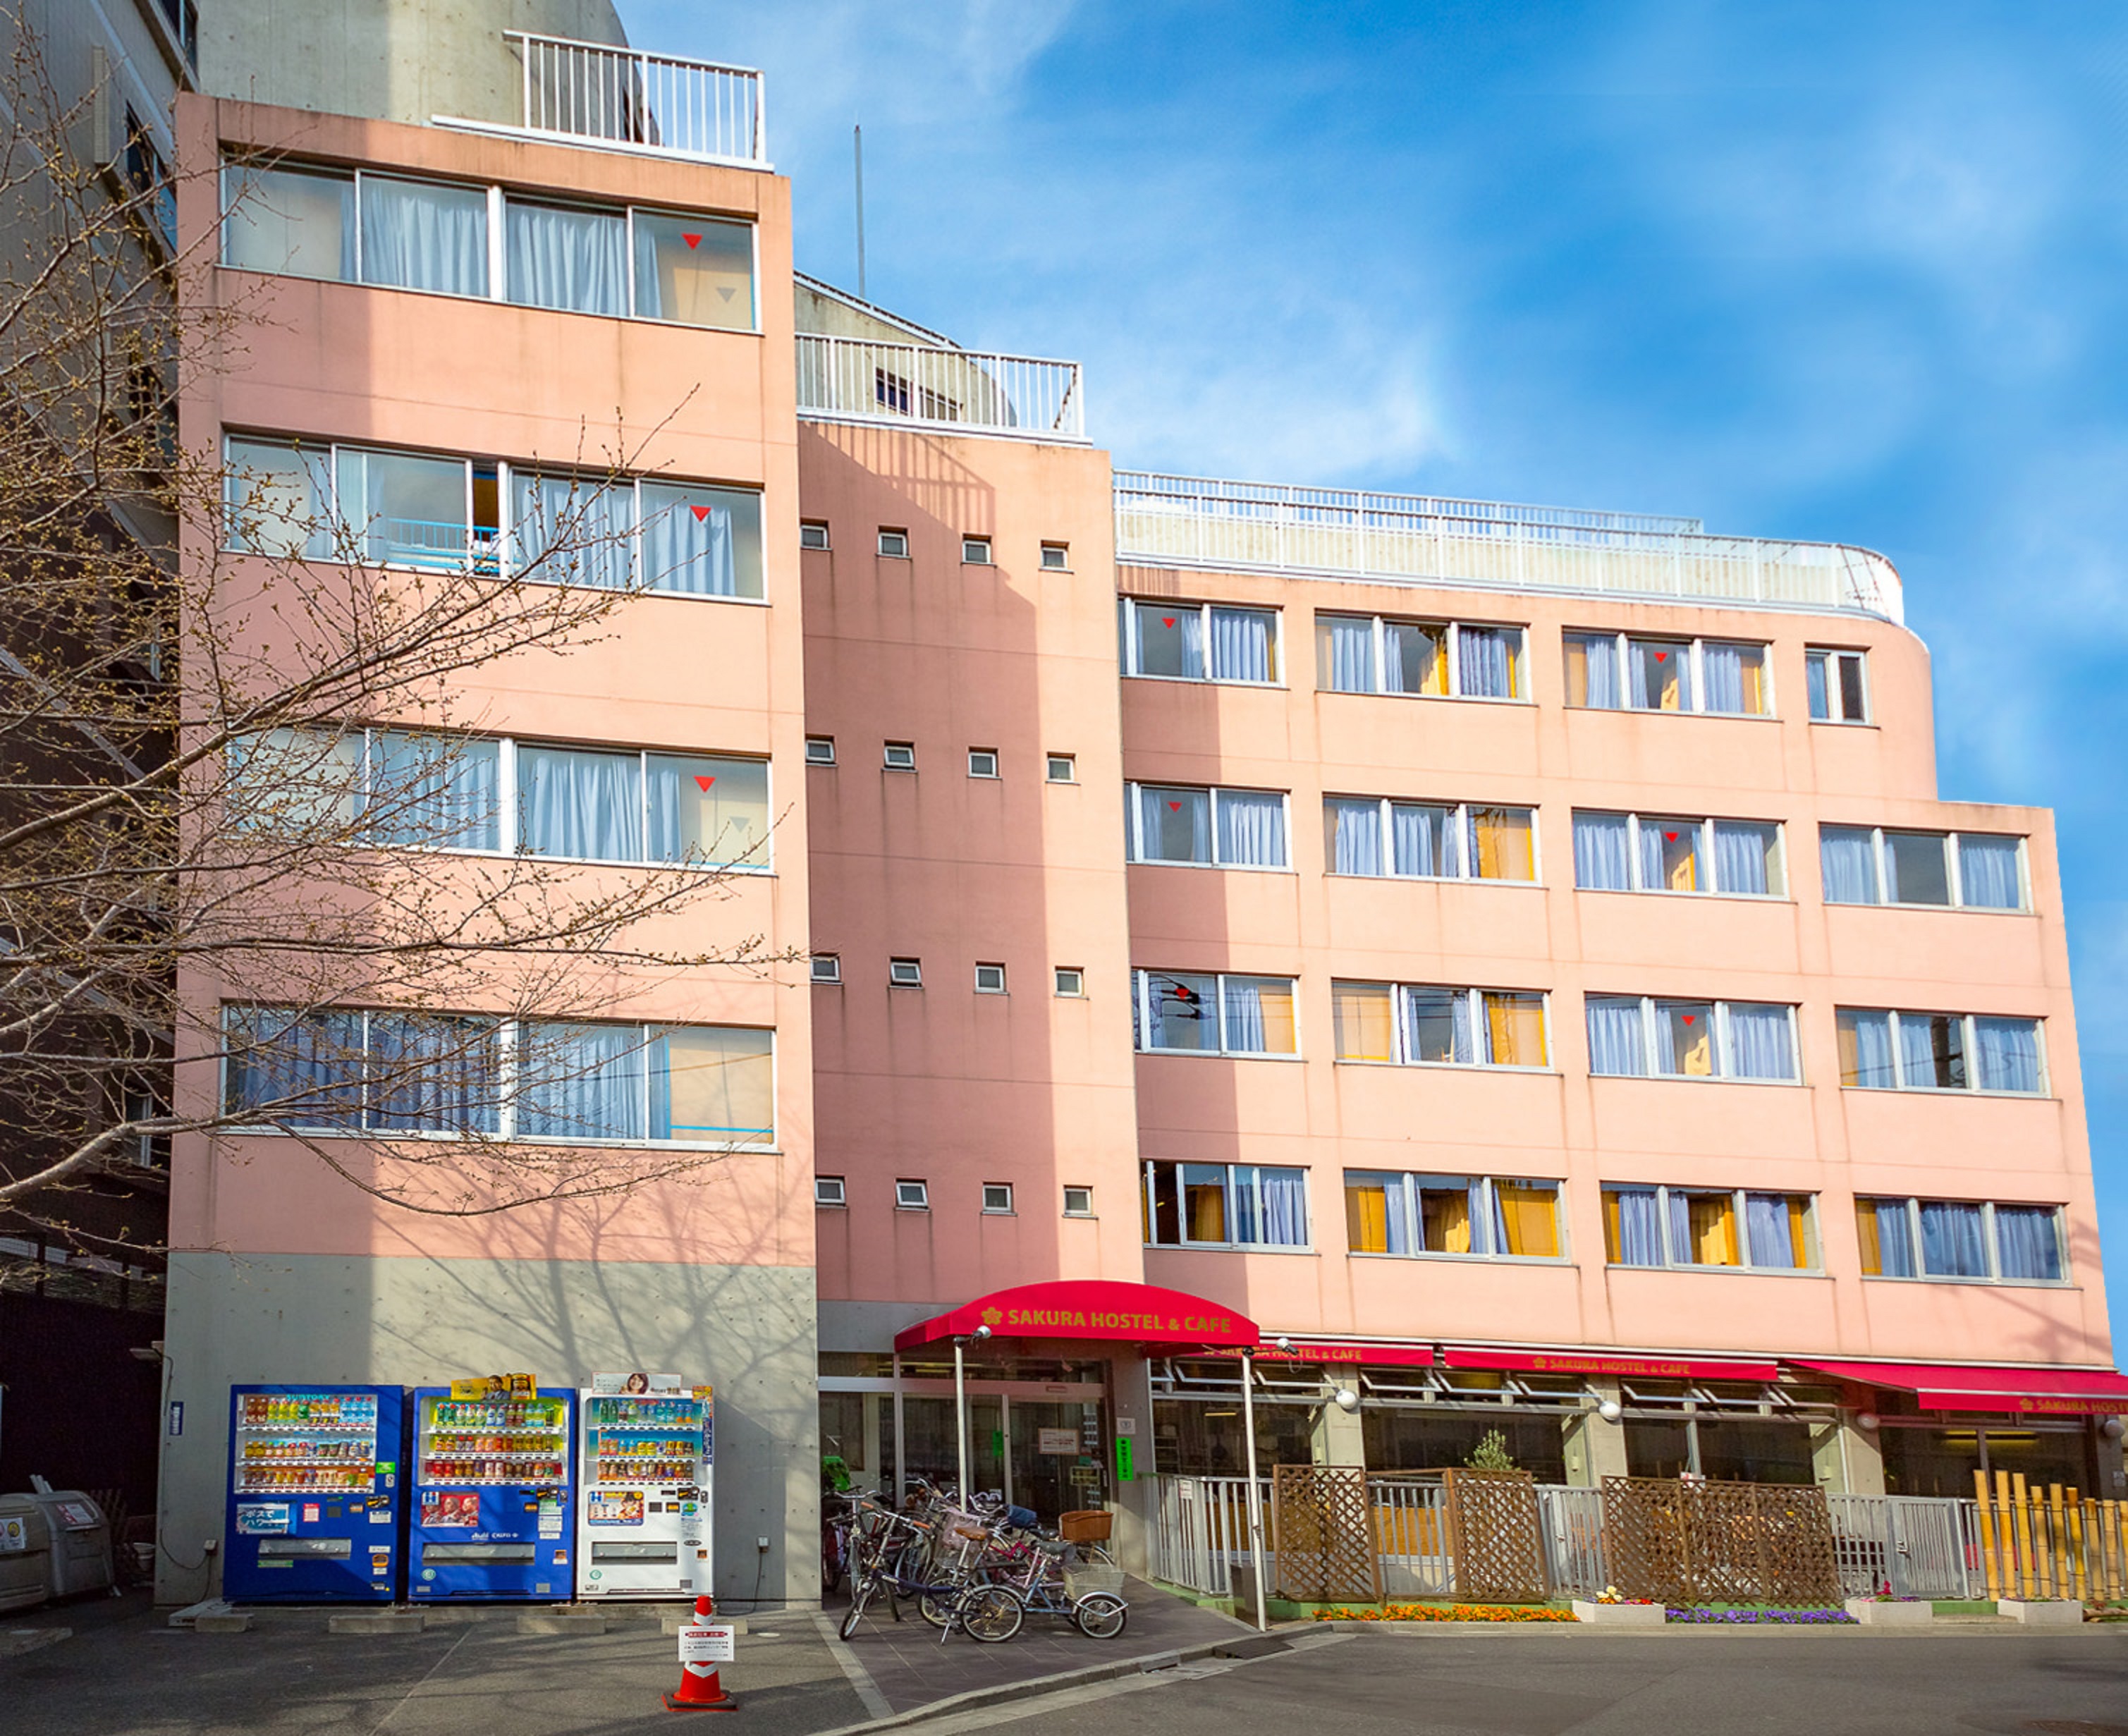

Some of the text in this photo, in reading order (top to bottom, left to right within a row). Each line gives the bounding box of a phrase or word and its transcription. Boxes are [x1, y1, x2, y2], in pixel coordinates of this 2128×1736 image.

[1008, 1309, 1231, 1333] SAKURA HOSTEL & CAFE
[1322, 1350, 1330, 1359] &
[1332, 1349, 1362, 1360] CAFE
[1550, 1358, 1691, 1374] SAKURA HOSTEL & CAFE
[2037, 1400, 2089, 1411] SAKURA
